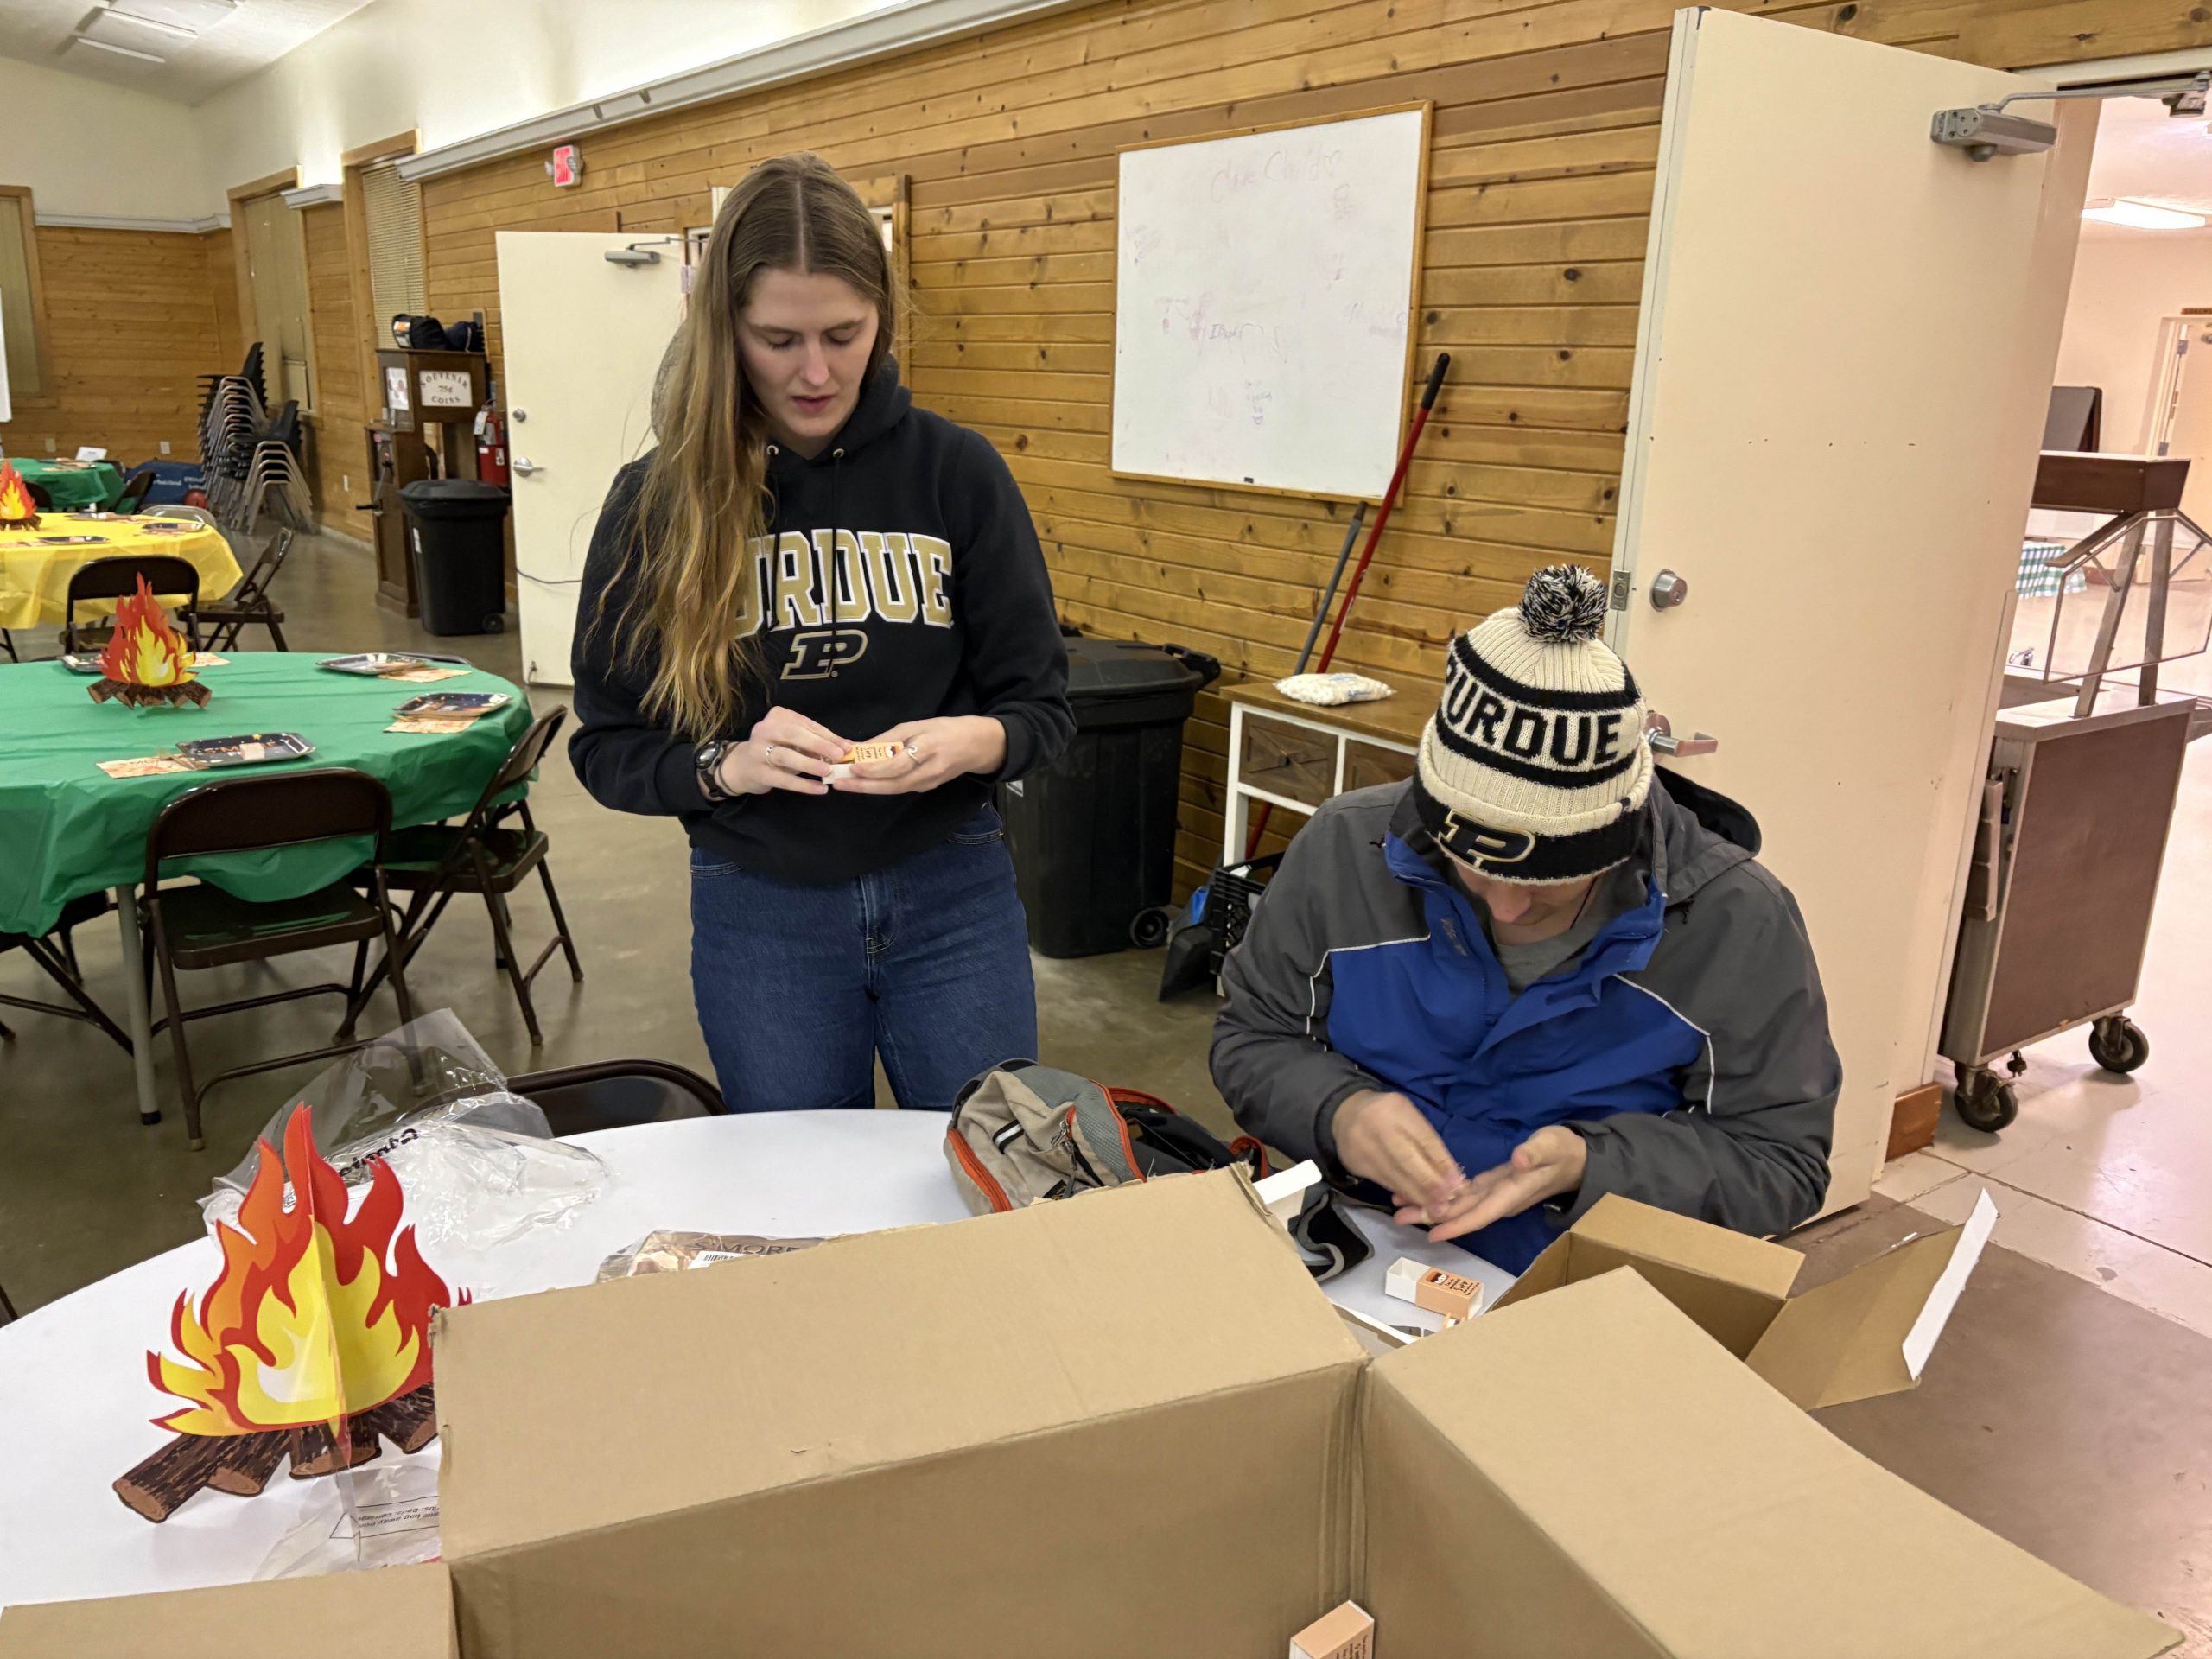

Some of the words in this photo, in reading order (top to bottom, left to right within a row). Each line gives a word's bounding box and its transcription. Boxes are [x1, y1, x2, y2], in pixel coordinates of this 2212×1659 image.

[421, 372, 468, 389] SOUVENIR
[431, 396, 461, 404] COINS
[730, 528, 955, 640] URDUE
